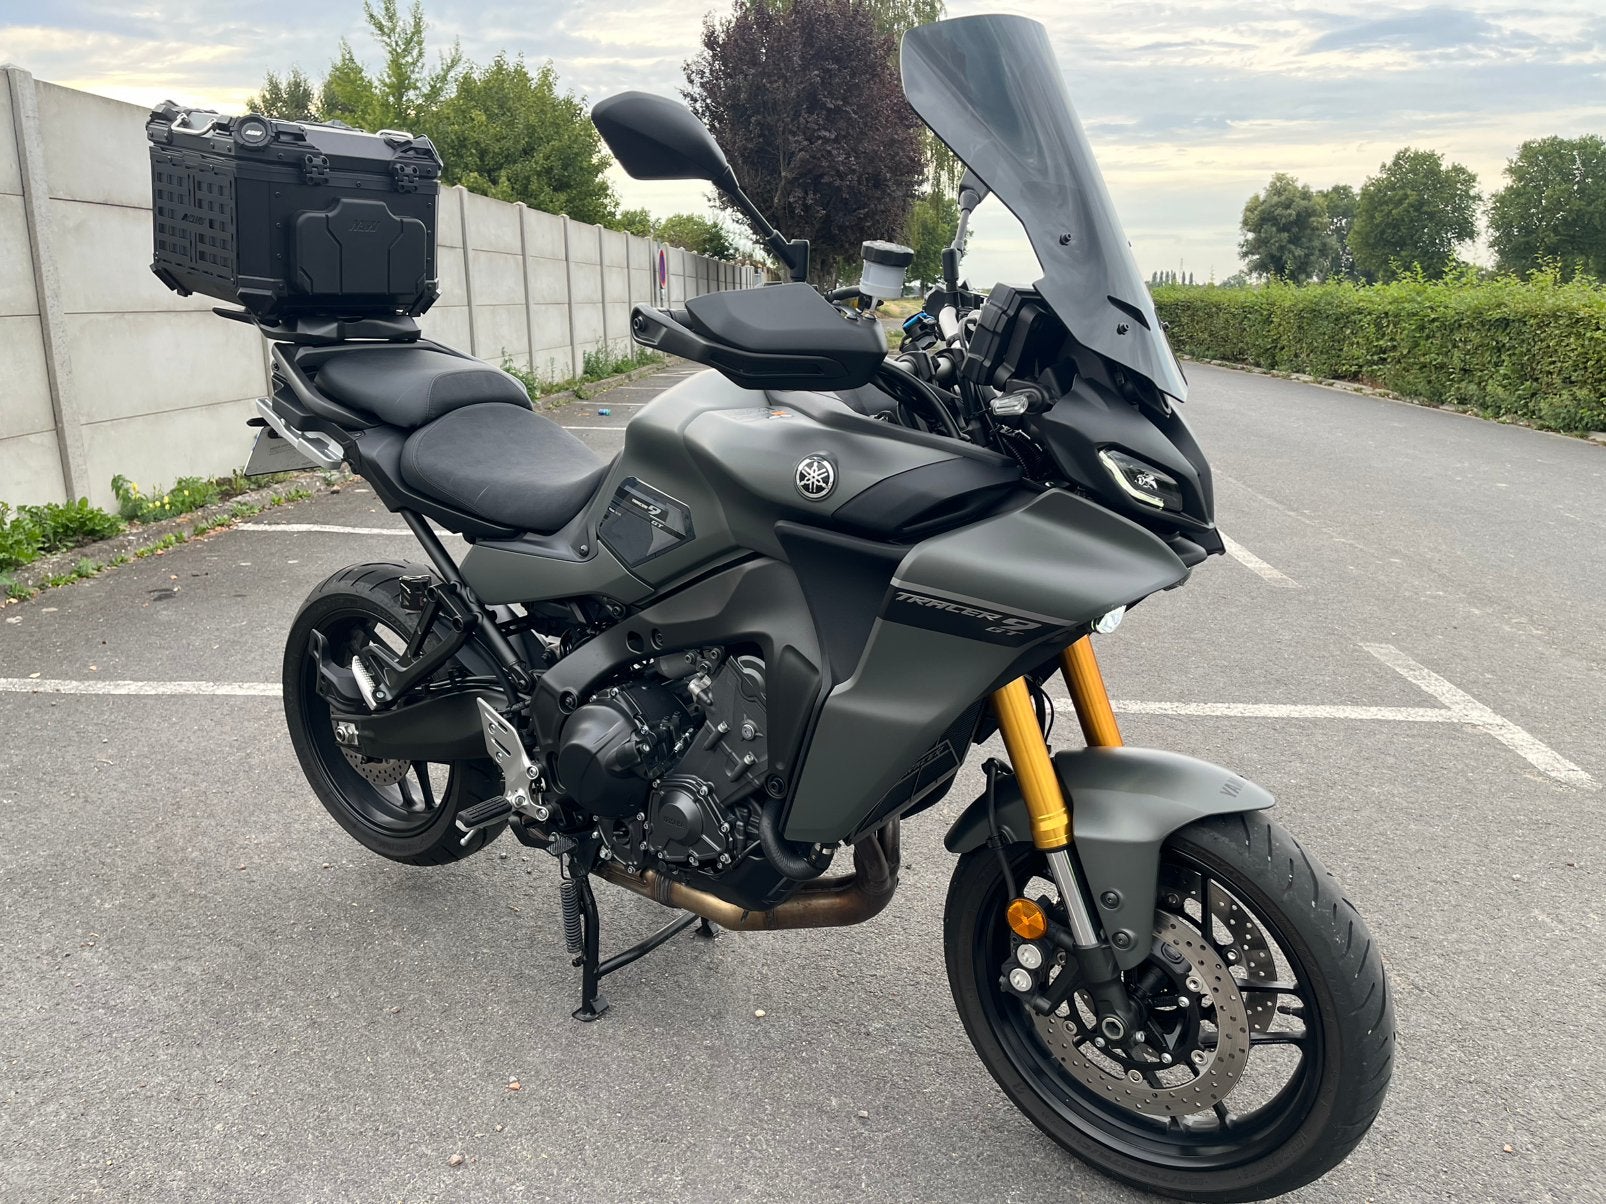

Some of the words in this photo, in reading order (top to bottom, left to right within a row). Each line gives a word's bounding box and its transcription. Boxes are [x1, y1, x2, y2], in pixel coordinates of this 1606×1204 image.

[895, 591, 1003, 621] TRACER
[1002, 617, 1042, 631] 9
[985, 626, 1025, 636] GT
